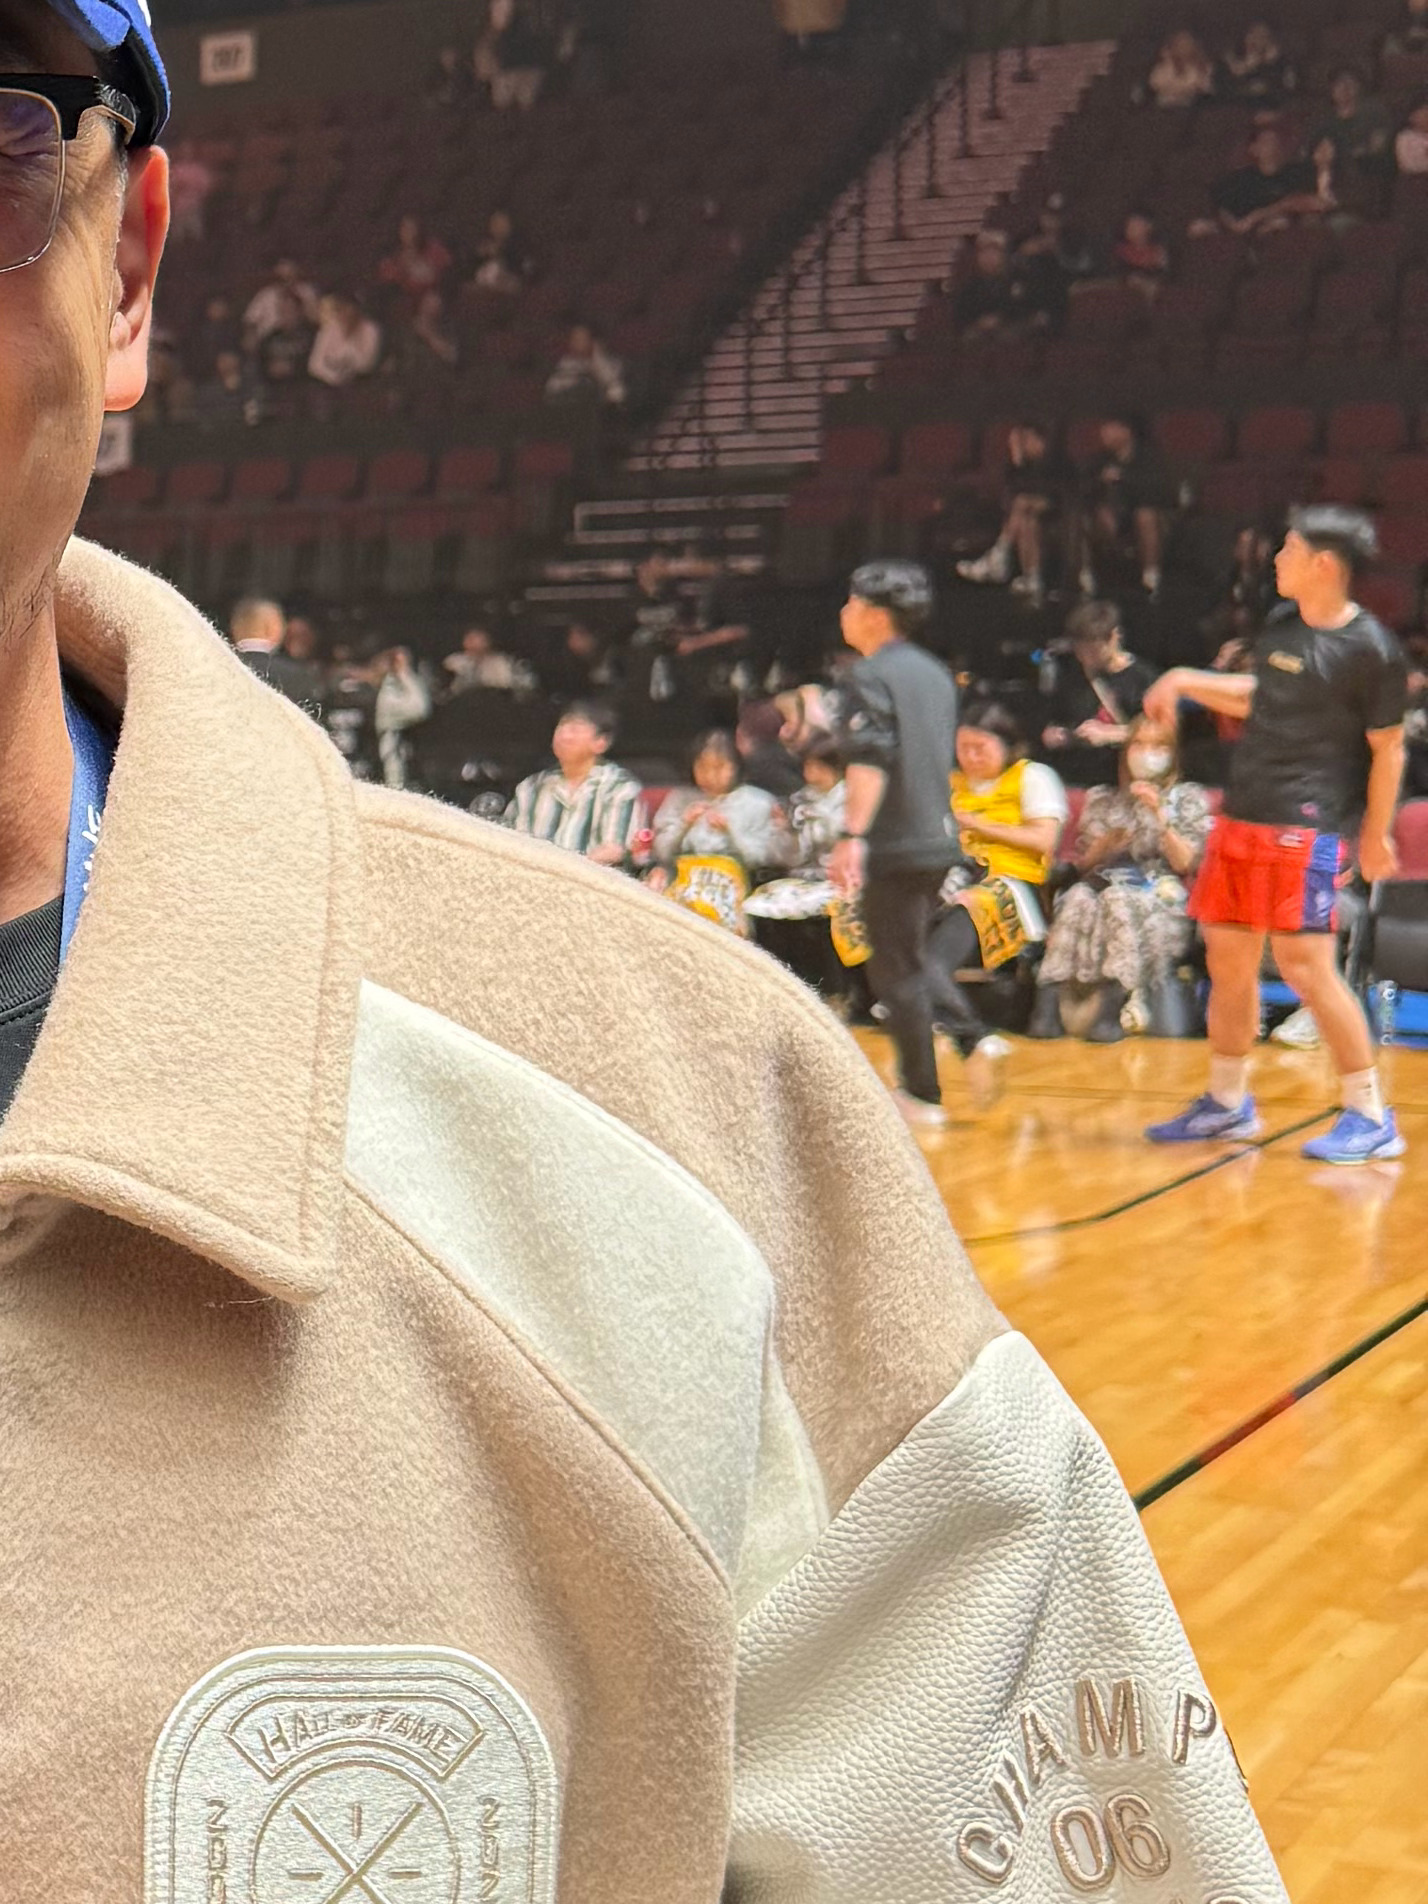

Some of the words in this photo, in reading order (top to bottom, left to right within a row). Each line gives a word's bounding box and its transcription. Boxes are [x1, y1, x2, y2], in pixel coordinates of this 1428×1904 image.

[257, 1710, 336, 1764] HALL
[372, 1709, 469, 1766] FAME
[1050, 1794, 1171, 1892] 06
